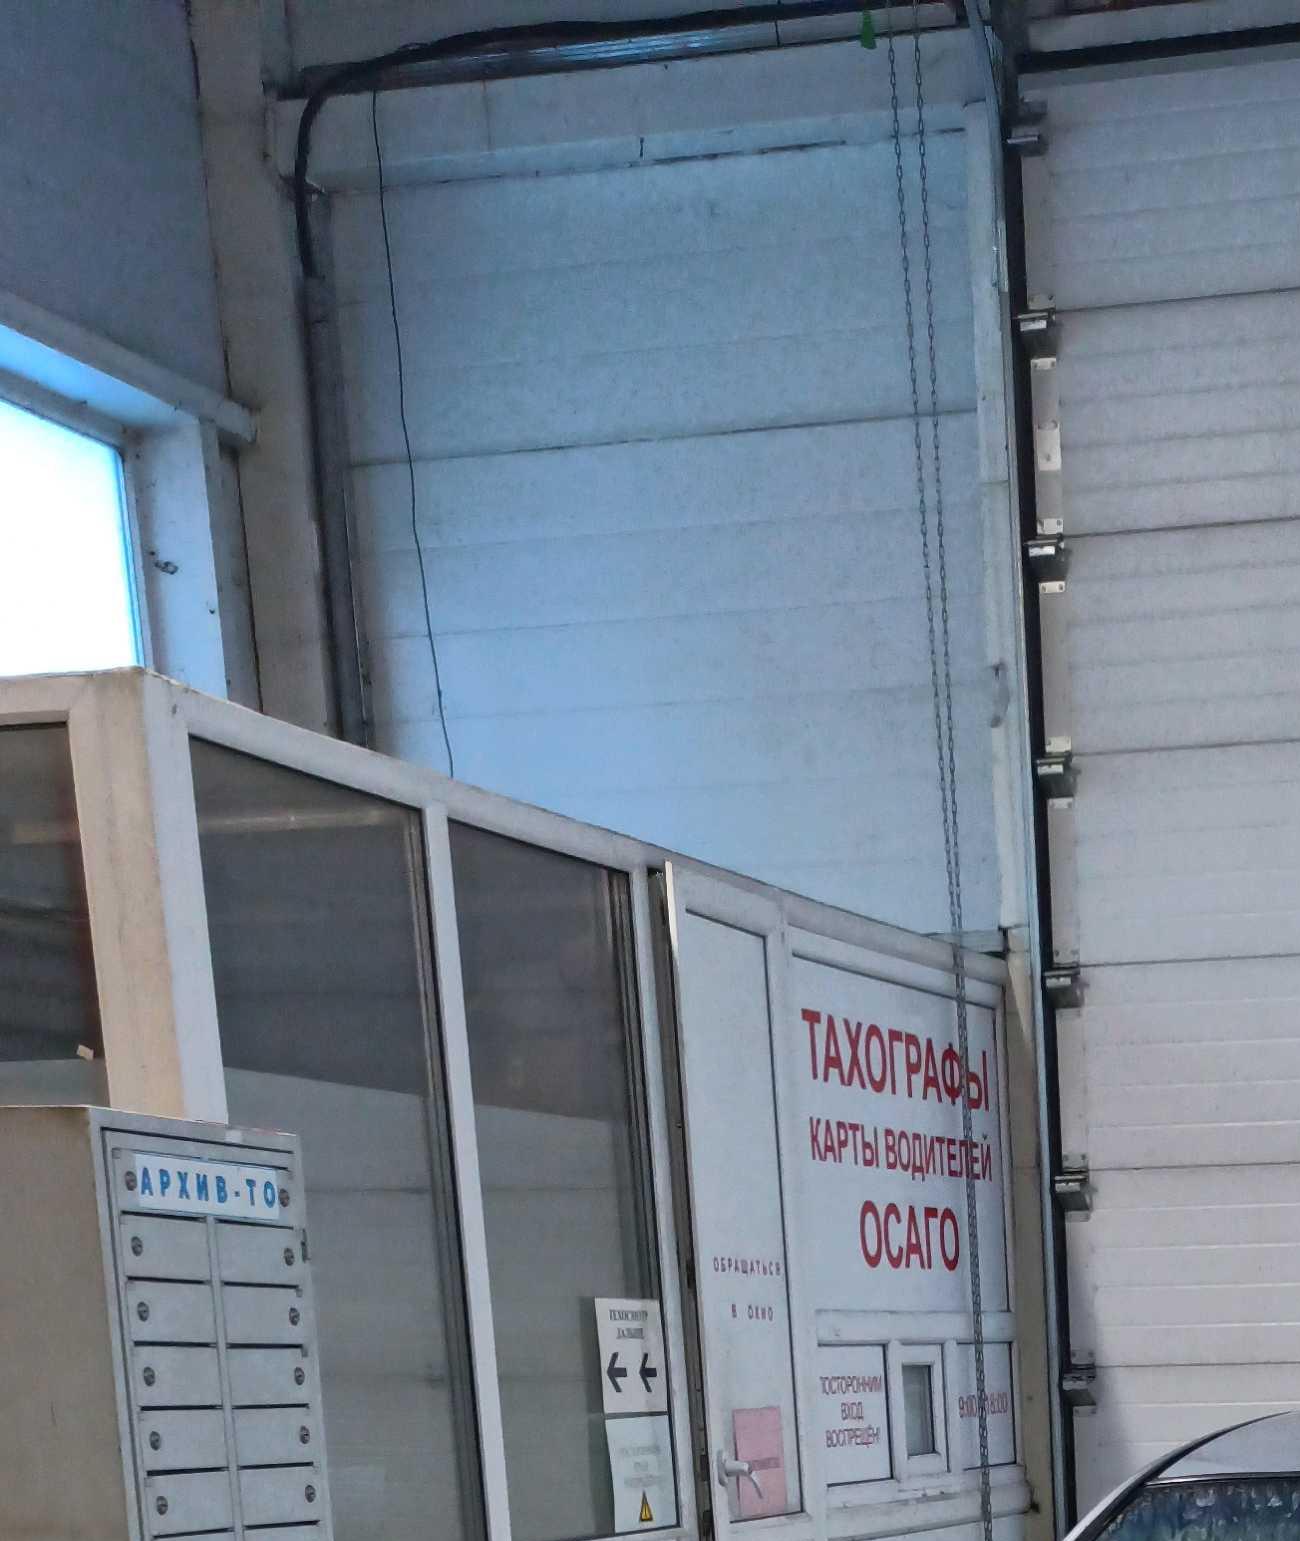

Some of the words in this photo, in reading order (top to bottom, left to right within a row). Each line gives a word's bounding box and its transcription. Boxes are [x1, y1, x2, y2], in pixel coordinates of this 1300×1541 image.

[801, 1008, 989, 1112] ТАХОГРАФЫ
[809, 1116, 880, 1168] КАРТЫ
[884, 1127, 993, 1182] ВОДИТЕЛЕЙ
[859, 1200, 961, 1272] ОСАГО
